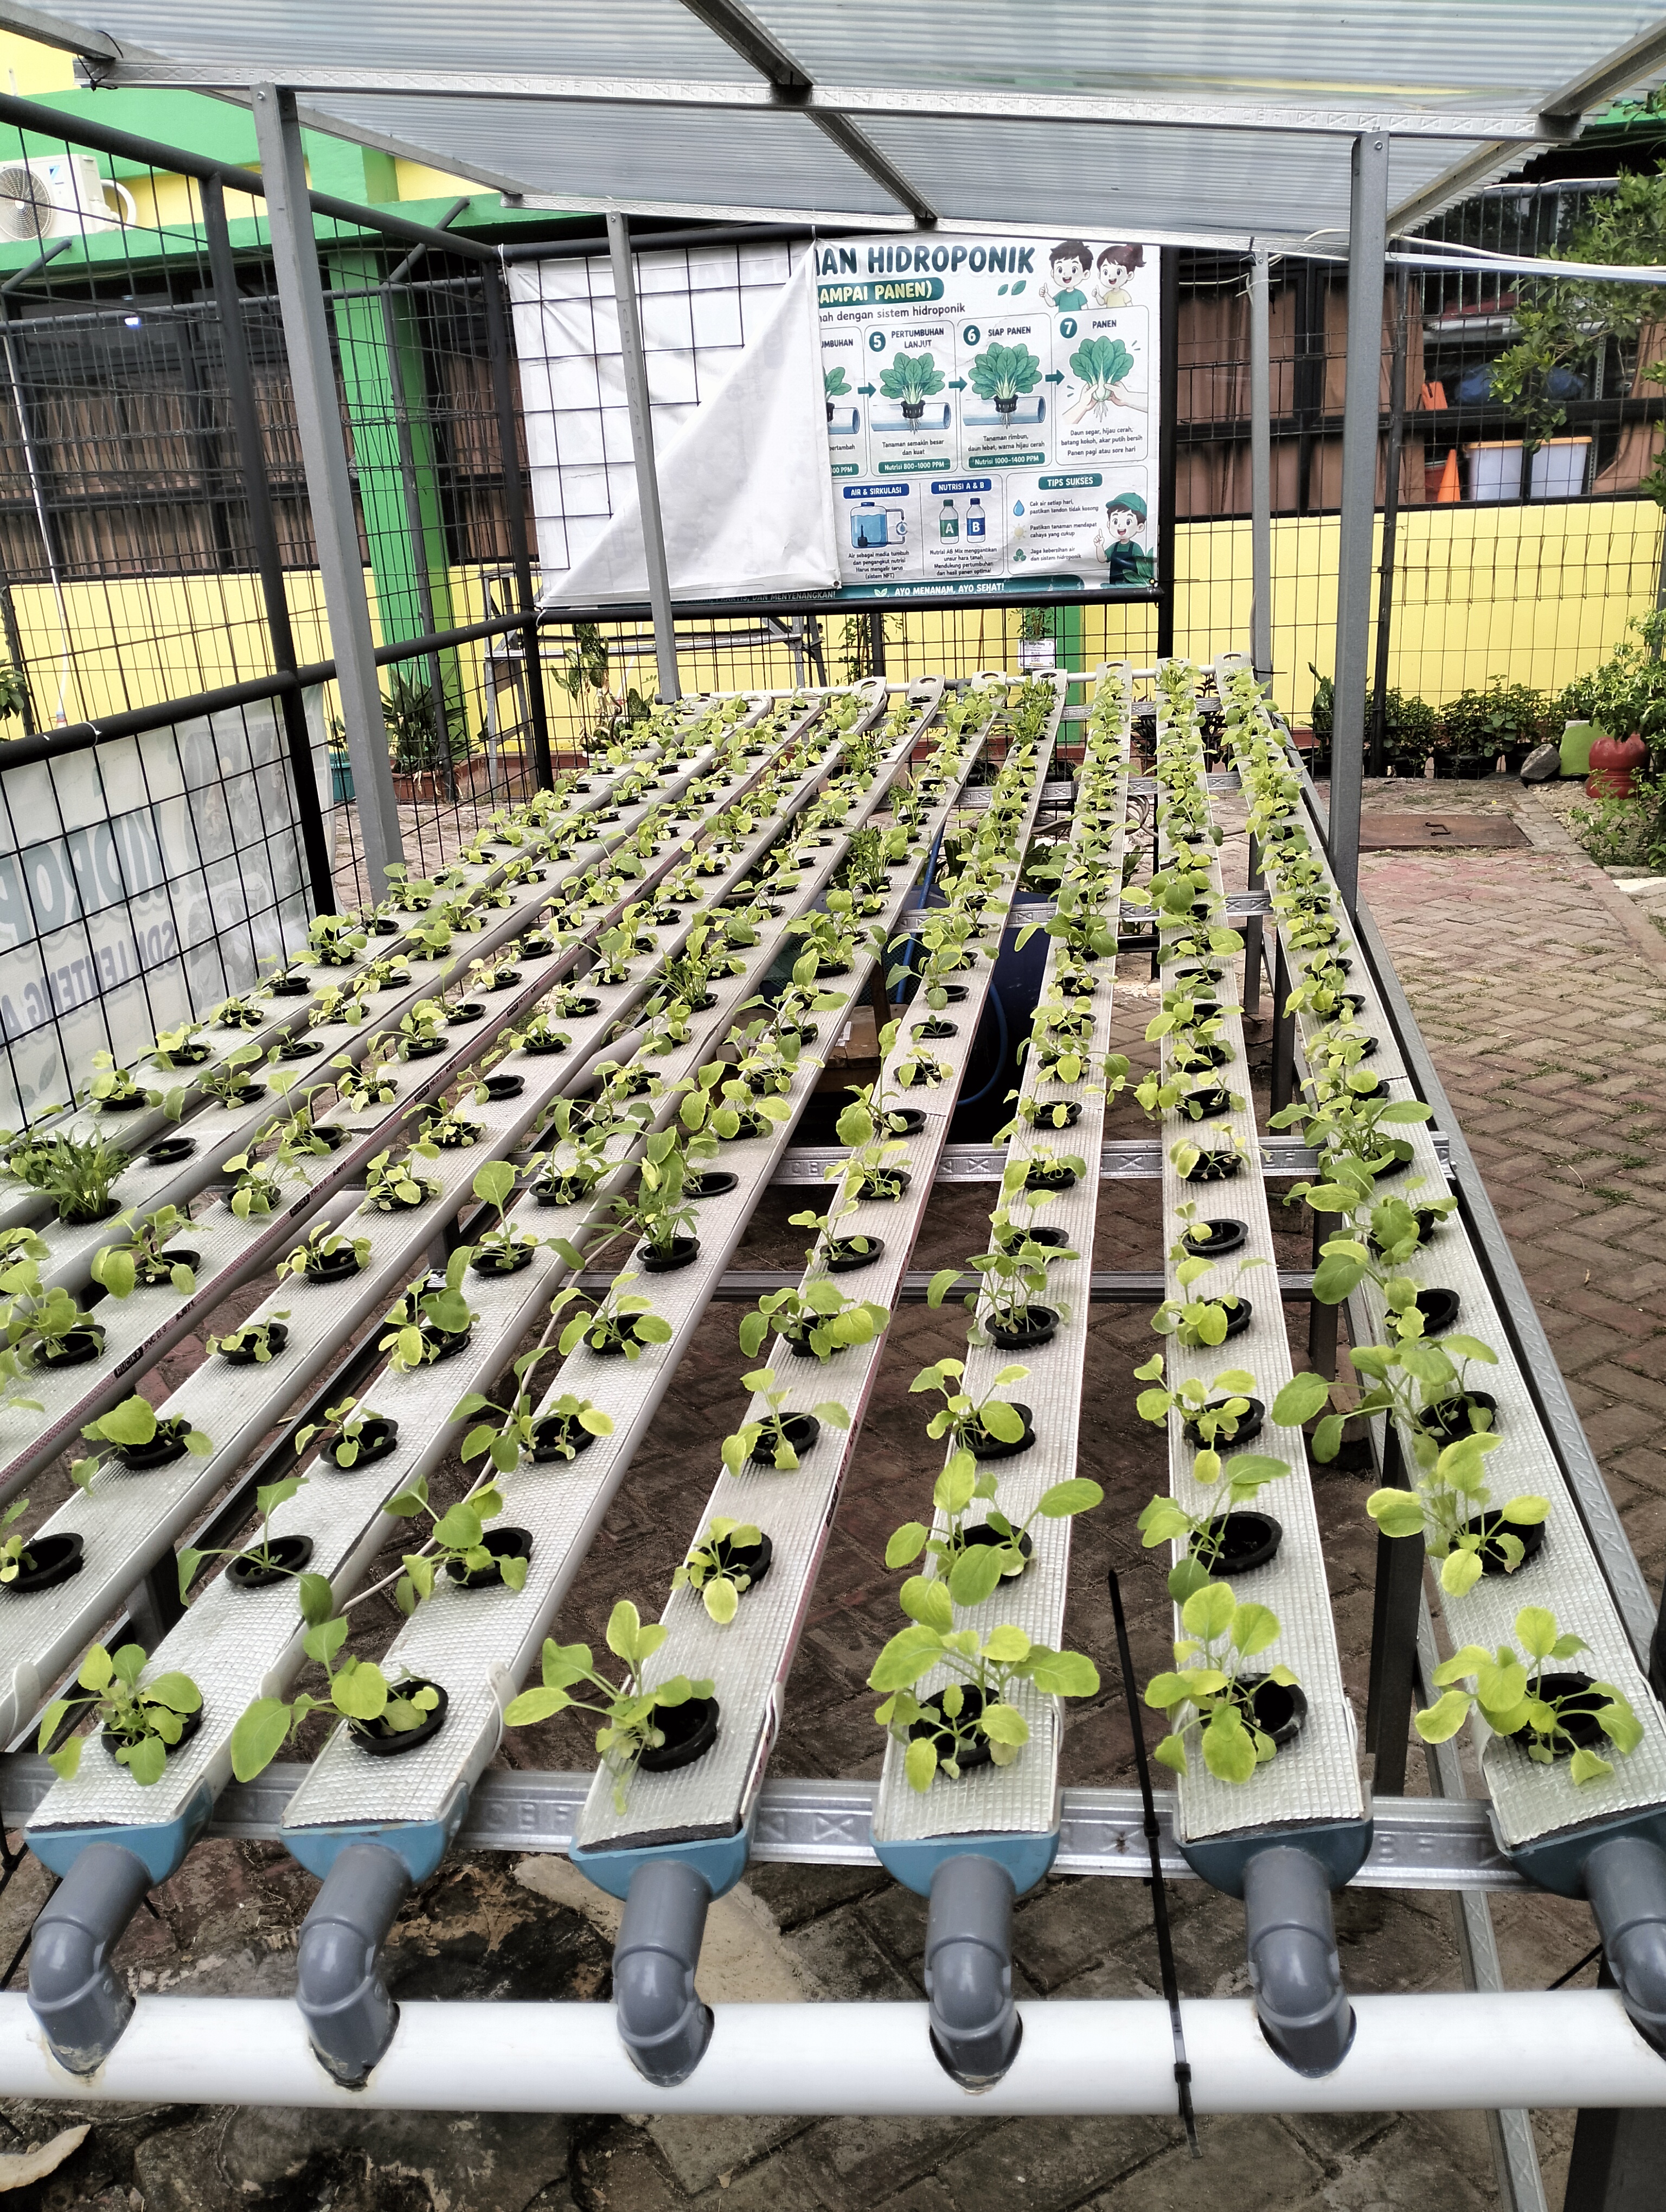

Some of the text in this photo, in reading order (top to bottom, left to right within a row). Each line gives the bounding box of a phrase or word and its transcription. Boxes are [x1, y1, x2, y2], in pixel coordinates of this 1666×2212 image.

[868, 246, 1035, 274] HIDROPONIK
[875, 280, 932, 300] PANEN)
[837, 311, 873, 323] dengan
[877, 308, 909, 318] sistem
[913, 303, 965, 318] hidroponik
[1063, 321, 1073, 335] 7
[1092, 319, 1117, 329] PANEN
[891, 328, 945, 338] PERTUMBUHAN
[967, 329, 977, 342] 6
[988, 326, 1031, 337] SIAP PANEN
[873, 335, 882, 349] 5
[904, 339, 932, 349] LANJUT
[1102, 427, 1116, 435] hijau
[1112, 436, 1126, 444] putih
[1085, 448, 1097, 456] pagi
[904, 461, 931, 470] 800-1000
[975, 457, 994, 465] Nutrisi
[938, 483, 964, 491] NUTRISI
[1047, 477, 1094, 487] TIPS SUKSES
[851, 488, 861, 496] AIR
[869, 486, 902, 495] SIRKULASI
[945, 523, 954, 533] A
[972, 522, 981, 532] B
[894, 583, 1004, 596] AYO MENANAM, AYO SEHAT!
[770, 590, 836, 600] MENYENANGKAN!
[115, 1349, 141, 1375] RUCIKA
[144, 1335, 157, 1349] PVC
